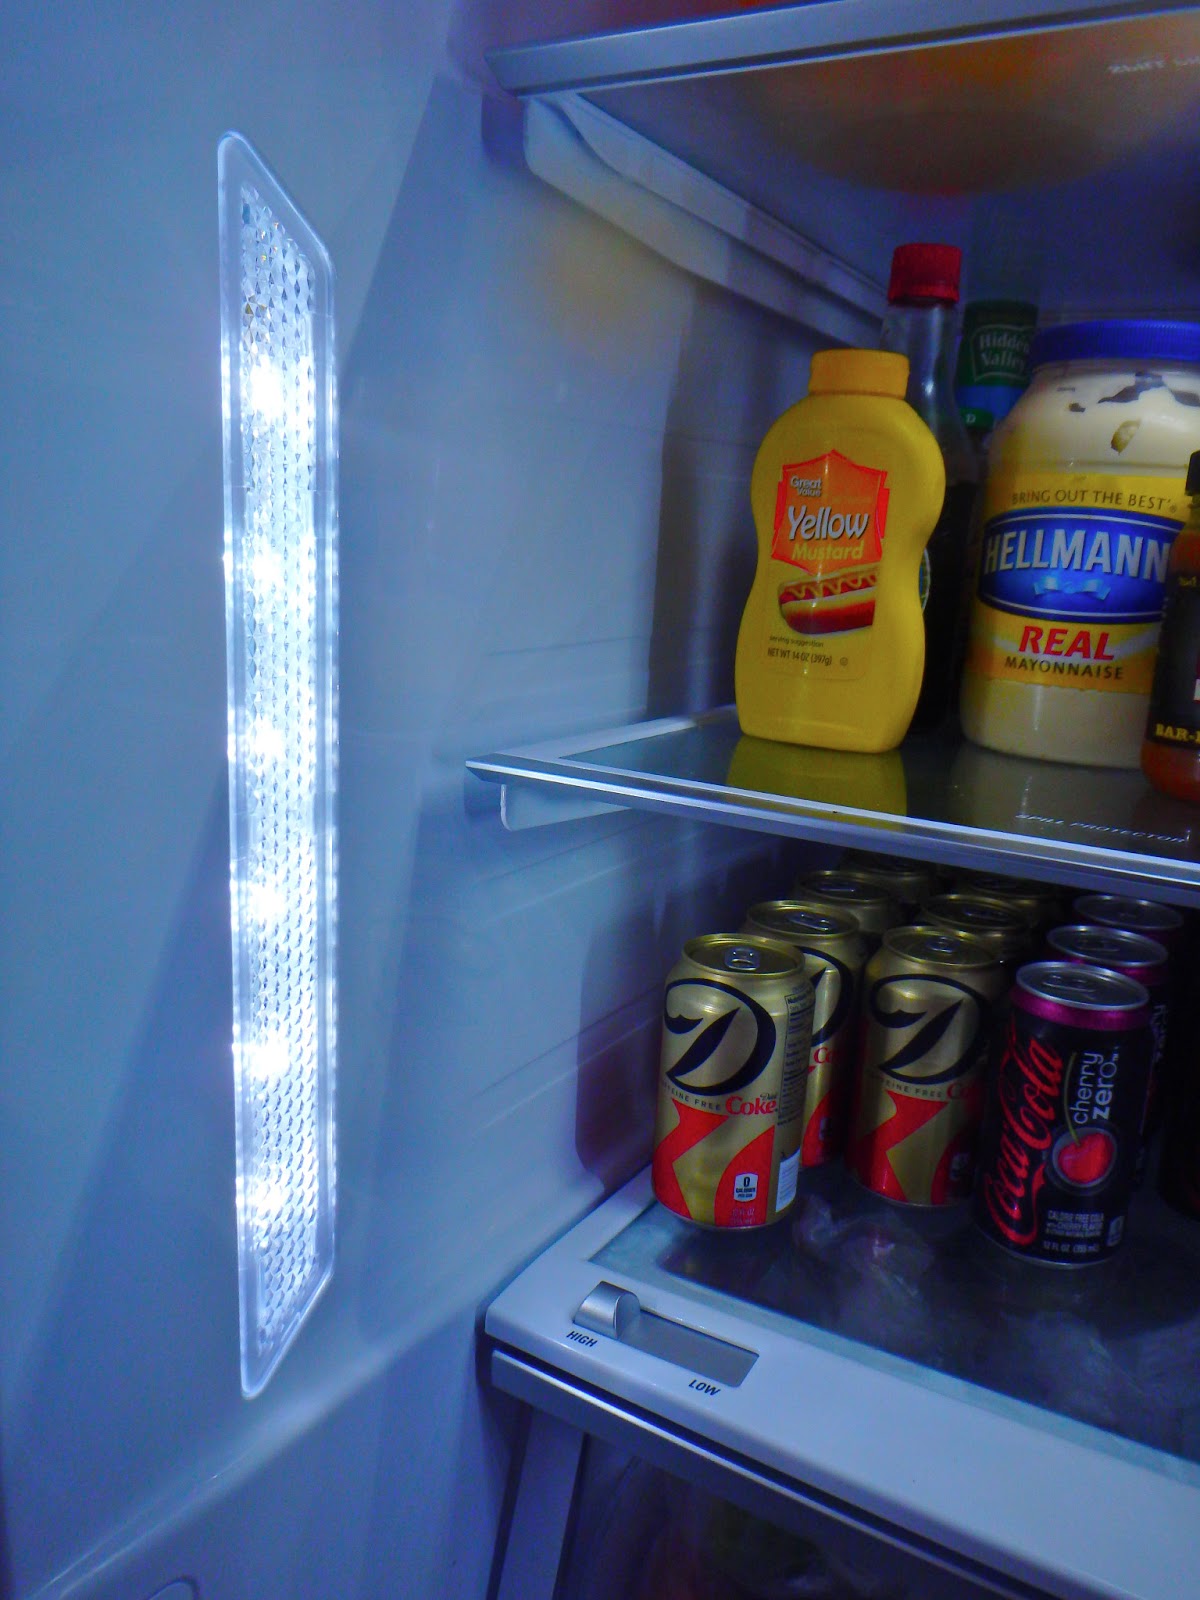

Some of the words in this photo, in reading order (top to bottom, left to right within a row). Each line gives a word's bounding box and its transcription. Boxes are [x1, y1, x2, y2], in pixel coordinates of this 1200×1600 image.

[790, 475, 823, 489] Great
[797, 486, 821, 497] Value
[1012, 489, 1050, 505] BRING
[1055, 489, 1086, 504] OUT
[1092, 490, 1122, 506] THE
[788, 504, 870, 541] Yellow
[791, 541, 864, 561] Mustard
[791, 637, 824, 648] suggestion
[1018, 625, 1115, 661] REAL
[767, 647, 779, 657] NET
[780, 649, 790, 659] WT
[792, 651, 799, 660] 14
[810, 653, 832, 667] (397g)
[1004, 656, 1125, 681] MAYONNAISE
[1070, 822, 1186, 843] PROTECTOR
[1070, 1052, 1103, 1125] cherry
[1093, 1059, 1119, 1121] zero
[694, 1098, 721, 1111] FREE
[725, 1096, 777, 1116] Coke
[565, 1330, 599, 1348] HIGH
[688, 1379, 721, 1397] LOW
